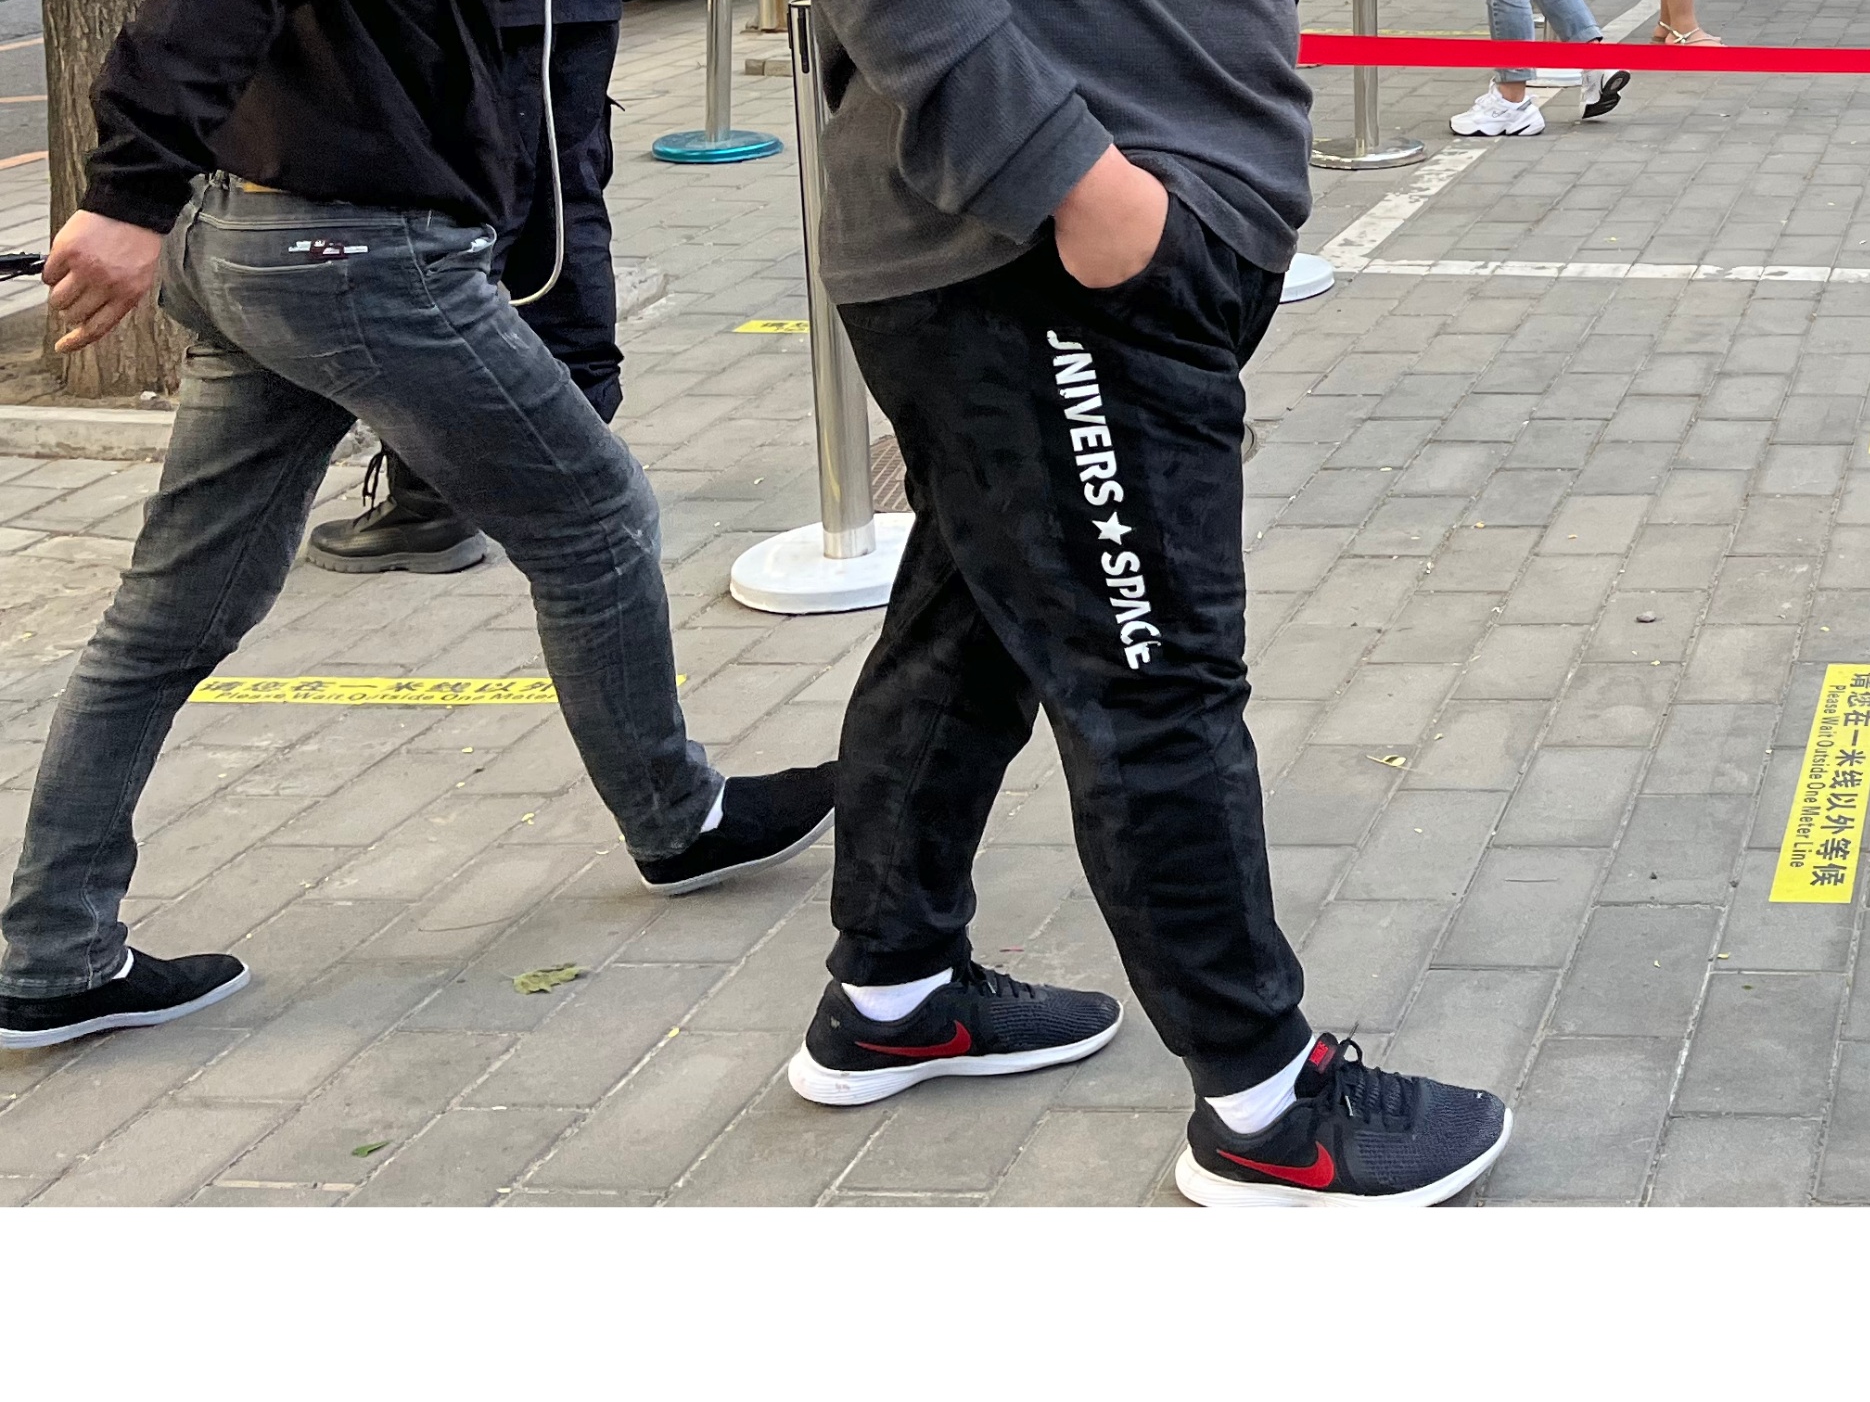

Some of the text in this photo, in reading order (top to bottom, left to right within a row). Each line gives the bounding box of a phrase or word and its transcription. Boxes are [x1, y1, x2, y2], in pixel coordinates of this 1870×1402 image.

[1101, 551, 1162, 670] SPACE
[349, 693, 434, 701] Outside
[1790, 685, 1846, 867] Please Wait Outside One Meter Line
